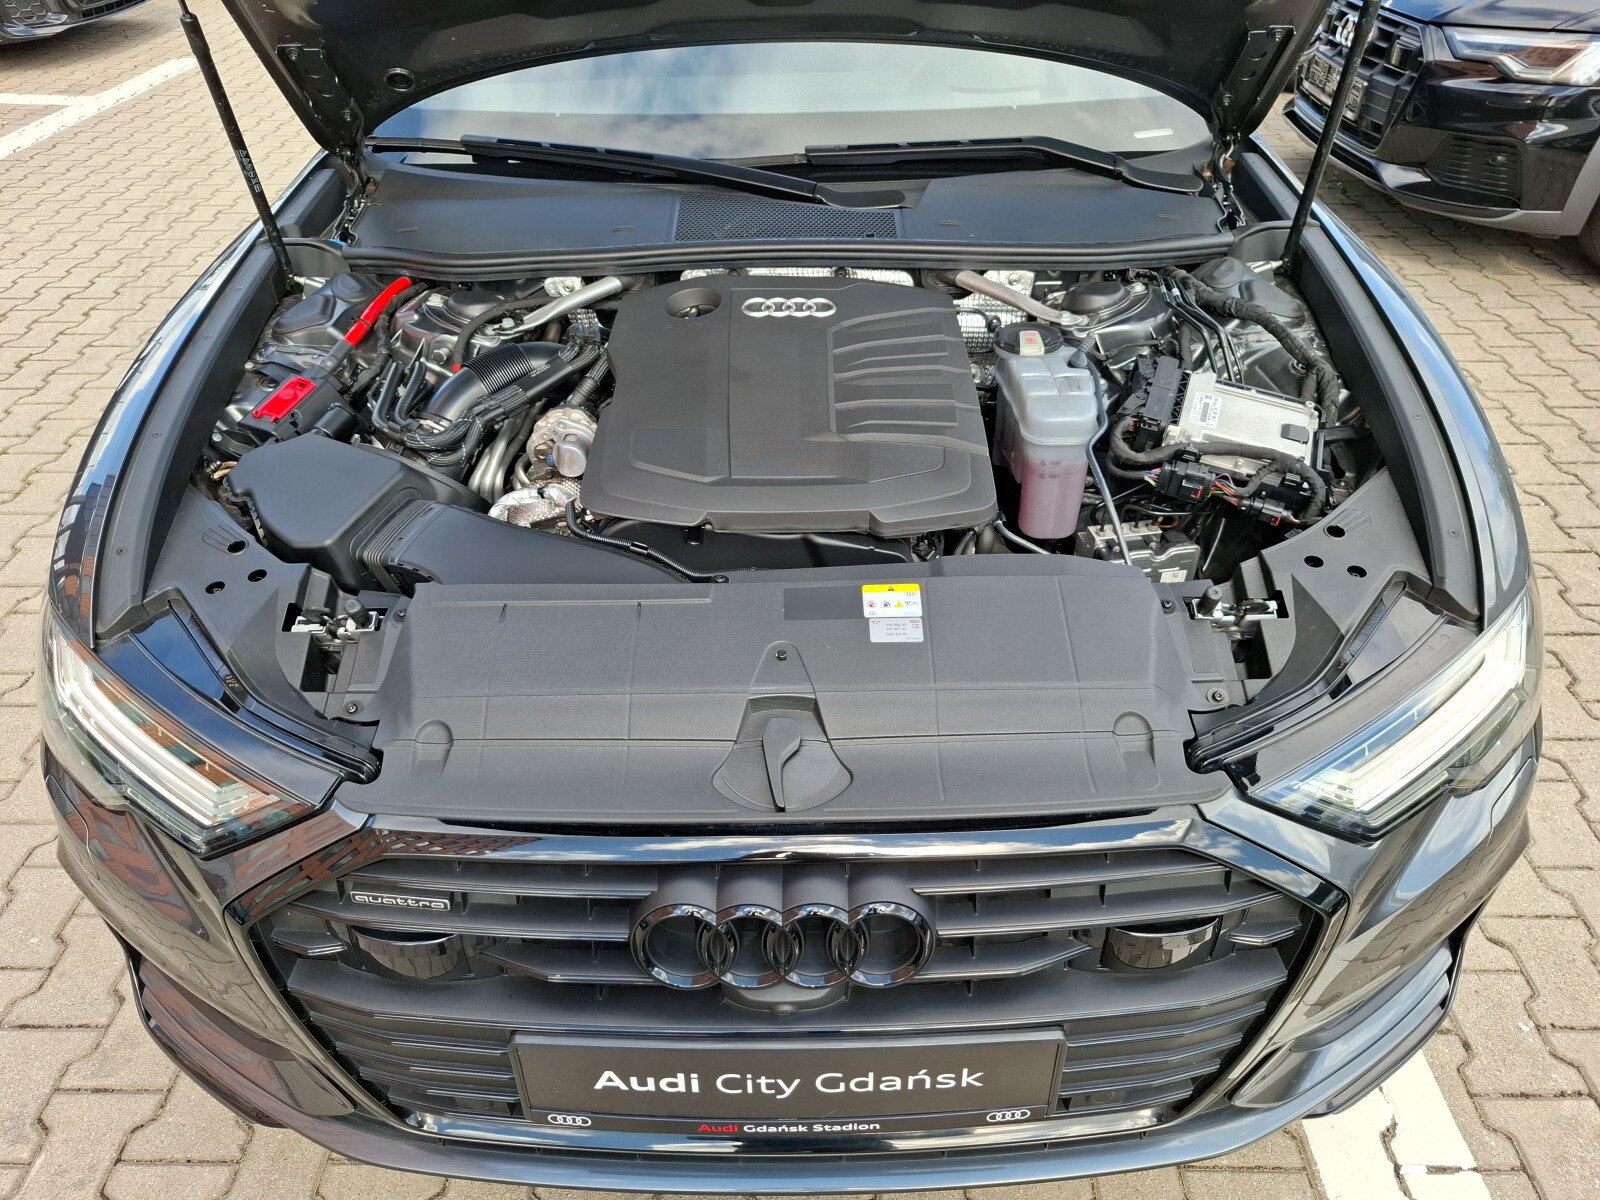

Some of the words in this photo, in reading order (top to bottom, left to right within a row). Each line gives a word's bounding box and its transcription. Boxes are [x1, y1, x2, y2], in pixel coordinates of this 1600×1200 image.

[354, 895, 445, 909] quattro
[593, 1070, 700, 1093] Audi
[715, 1073, 801, 1099] City
[815, 1068, 985, 1093] Gdańsk
[697, 1124, 739, 1133] Audi
[743, 1123, 808, 1133] Gdańsk
[812, 1122, 881, 1132] Stadion
